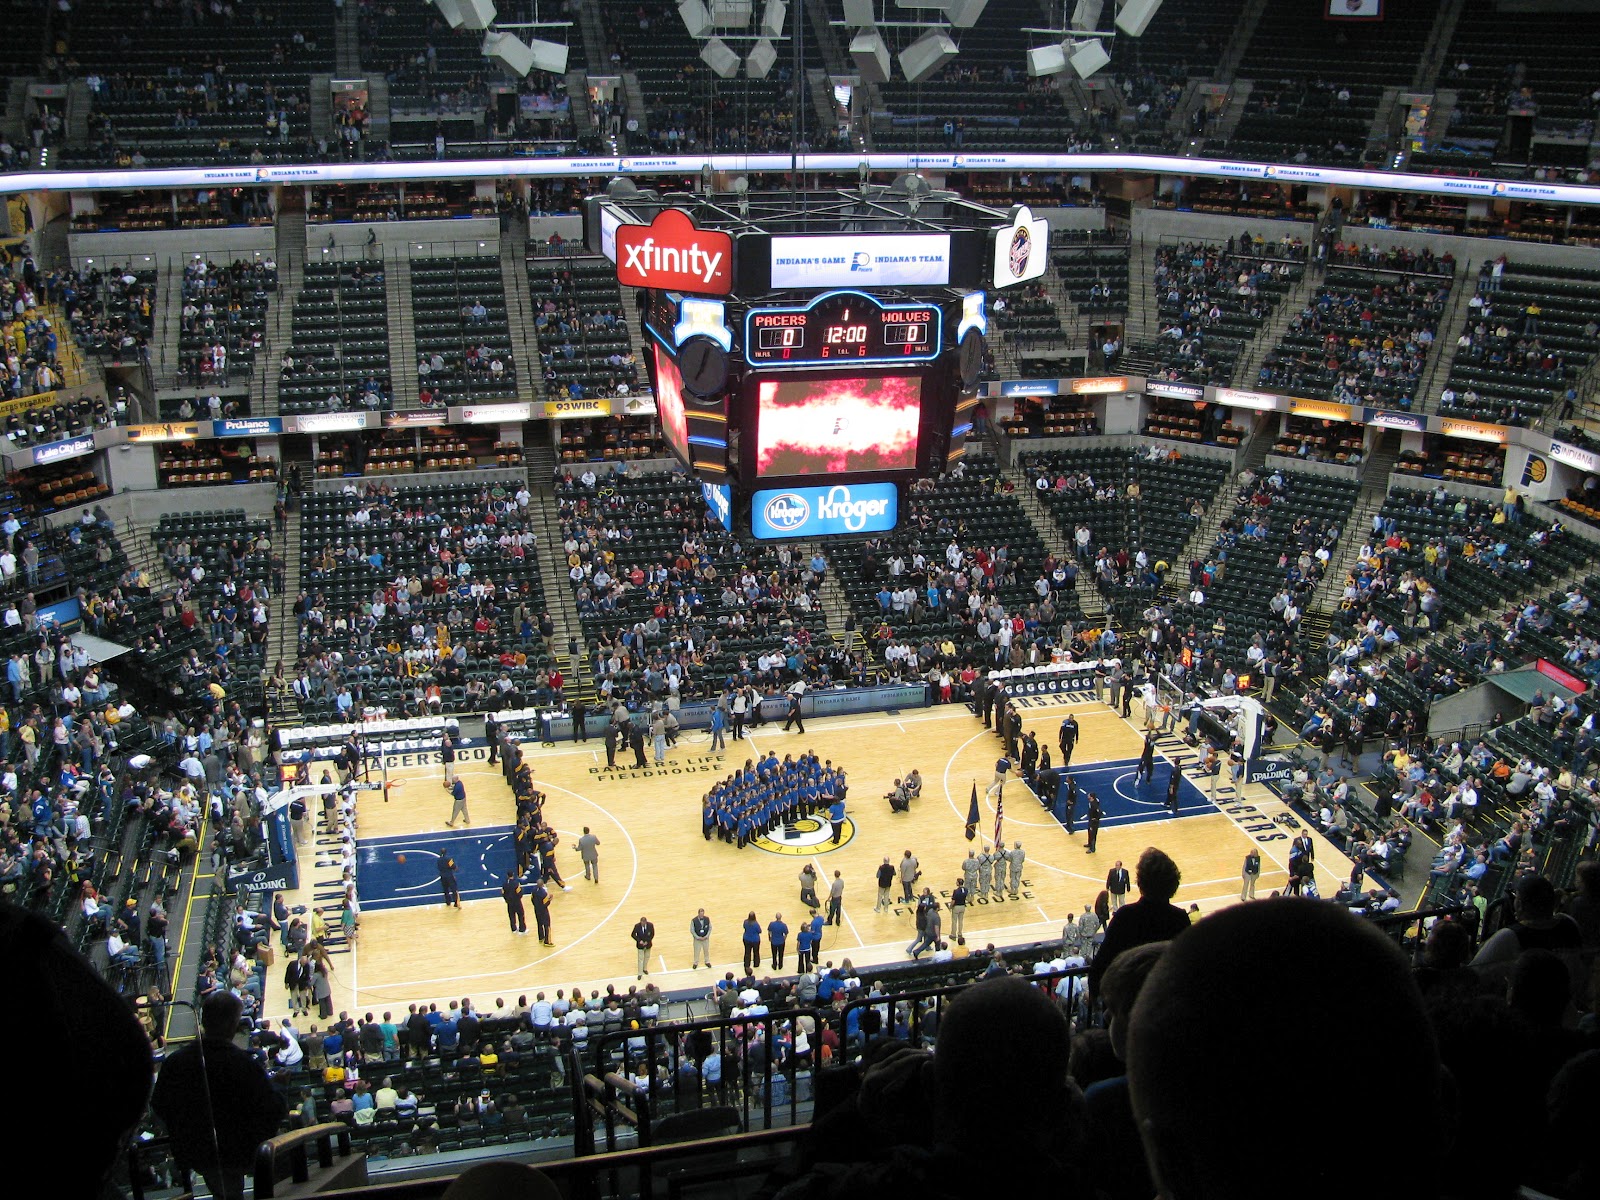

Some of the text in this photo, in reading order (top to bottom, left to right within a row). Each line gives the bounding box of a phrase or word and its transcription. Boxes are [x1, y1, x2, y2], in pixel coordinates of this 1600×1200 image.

[624, 237, 723, 284] xfinity
[776, 257, 819, 265] INDIANA'S
[875, 255, 917, 263] INDIANA'S
[755, 315, 807, 326] PACERS
[881, 312, 931, 323] WOLVES
[827, 326, 867, 343] 12:00
[782, 348, 790, 359] 0
[904, 343, 912, 354] 0
[1147, 382, 1203, 396] SPORT GRAPHICS
[226, 420, 270, 430] ProLiance
[42, 438, 94, 459] Lake City Bank
[1561, 445, 1593, 466] INDIANA
[770, 500, 805, 526] Kroger
[817, 485, 889, 530] Kroger
[358, 749, 486, 770] PACERSCO
[589, 755, 726, 774] BANKERS LIFE
[598, 764, 723, 781] FIELDHOUSE
[1251, 767, 1291, 783] SPALDING
